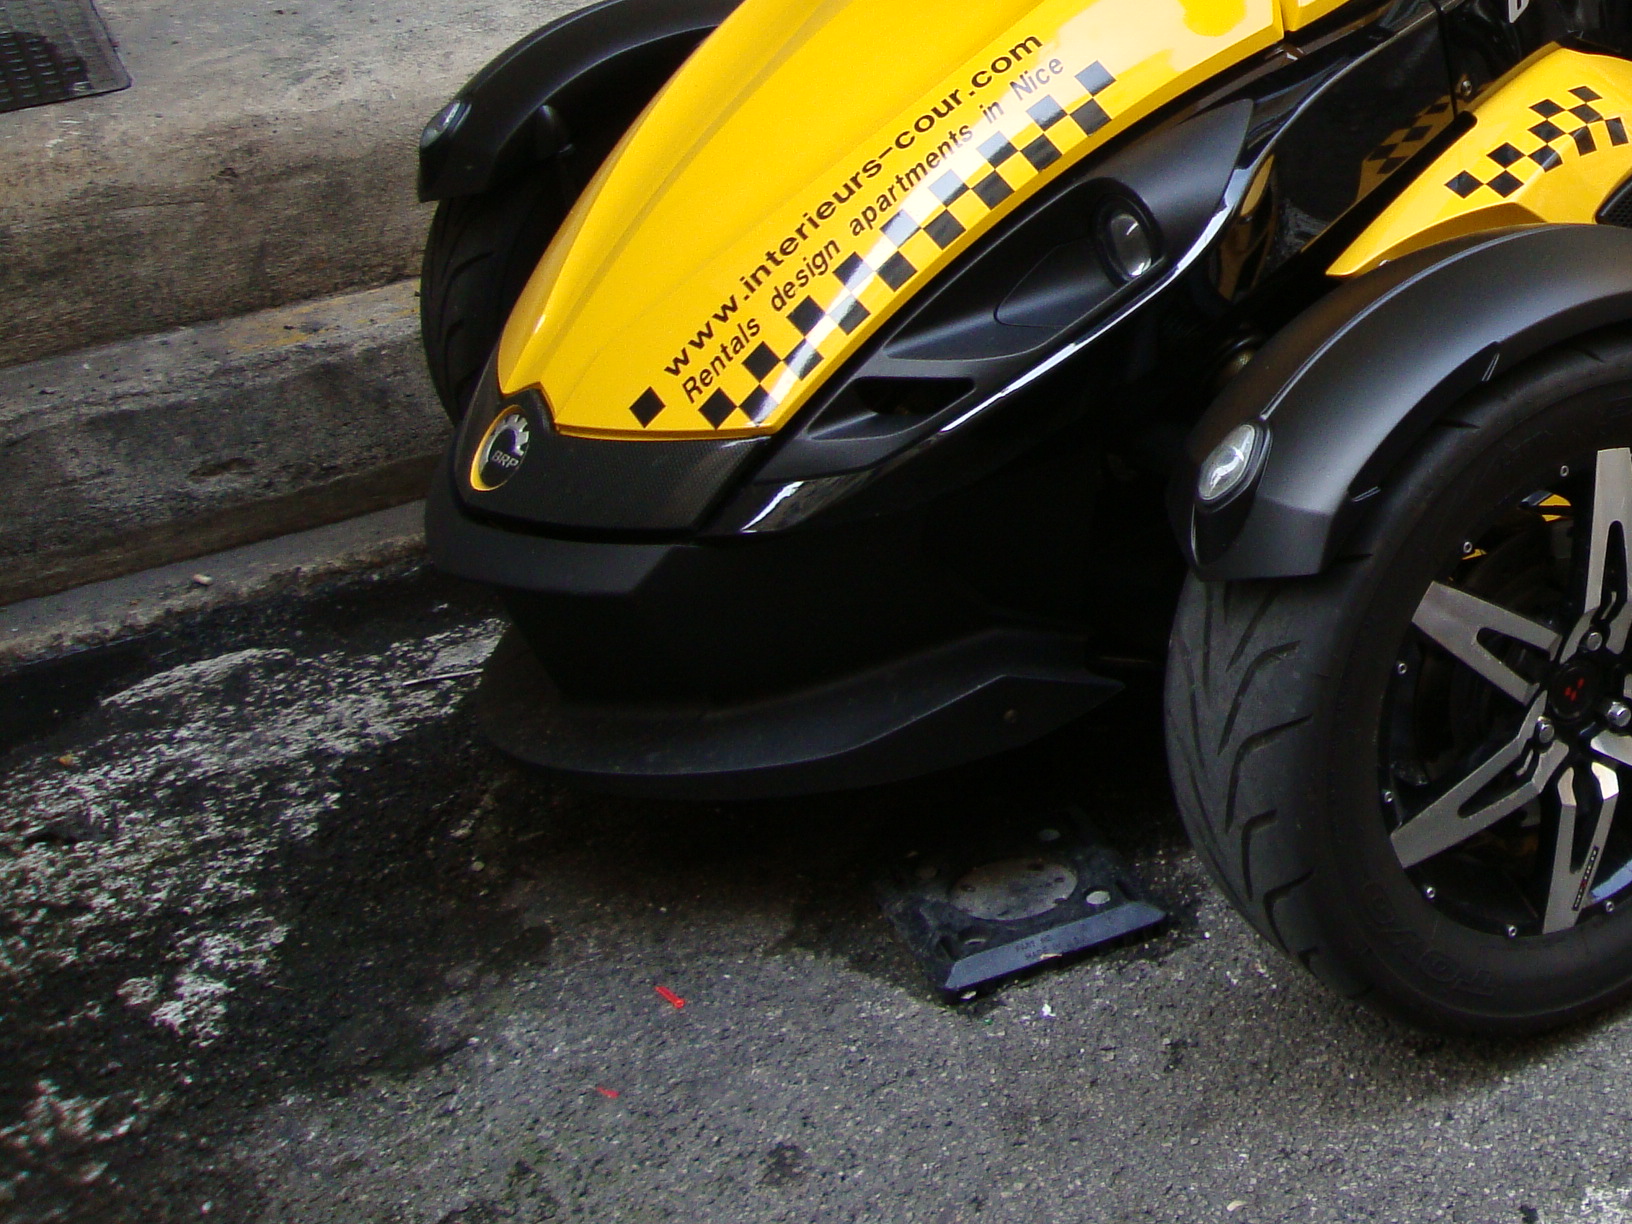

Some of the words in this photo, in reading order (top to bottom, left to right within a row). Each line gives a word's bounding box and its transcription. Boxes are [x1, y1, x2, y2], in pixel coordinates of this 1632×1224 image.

[663, 34, 1043, 378] www.interieurs-cour.com
[682, 317, 761, 404] Rentals
[770, 240, 841, 311] design
[849, 124, 974, 236] apartments
[981, 99, 1004, 122] in
[1009, 54, 1064, 97] Nice
[491, 450, 519, 468] BRP
